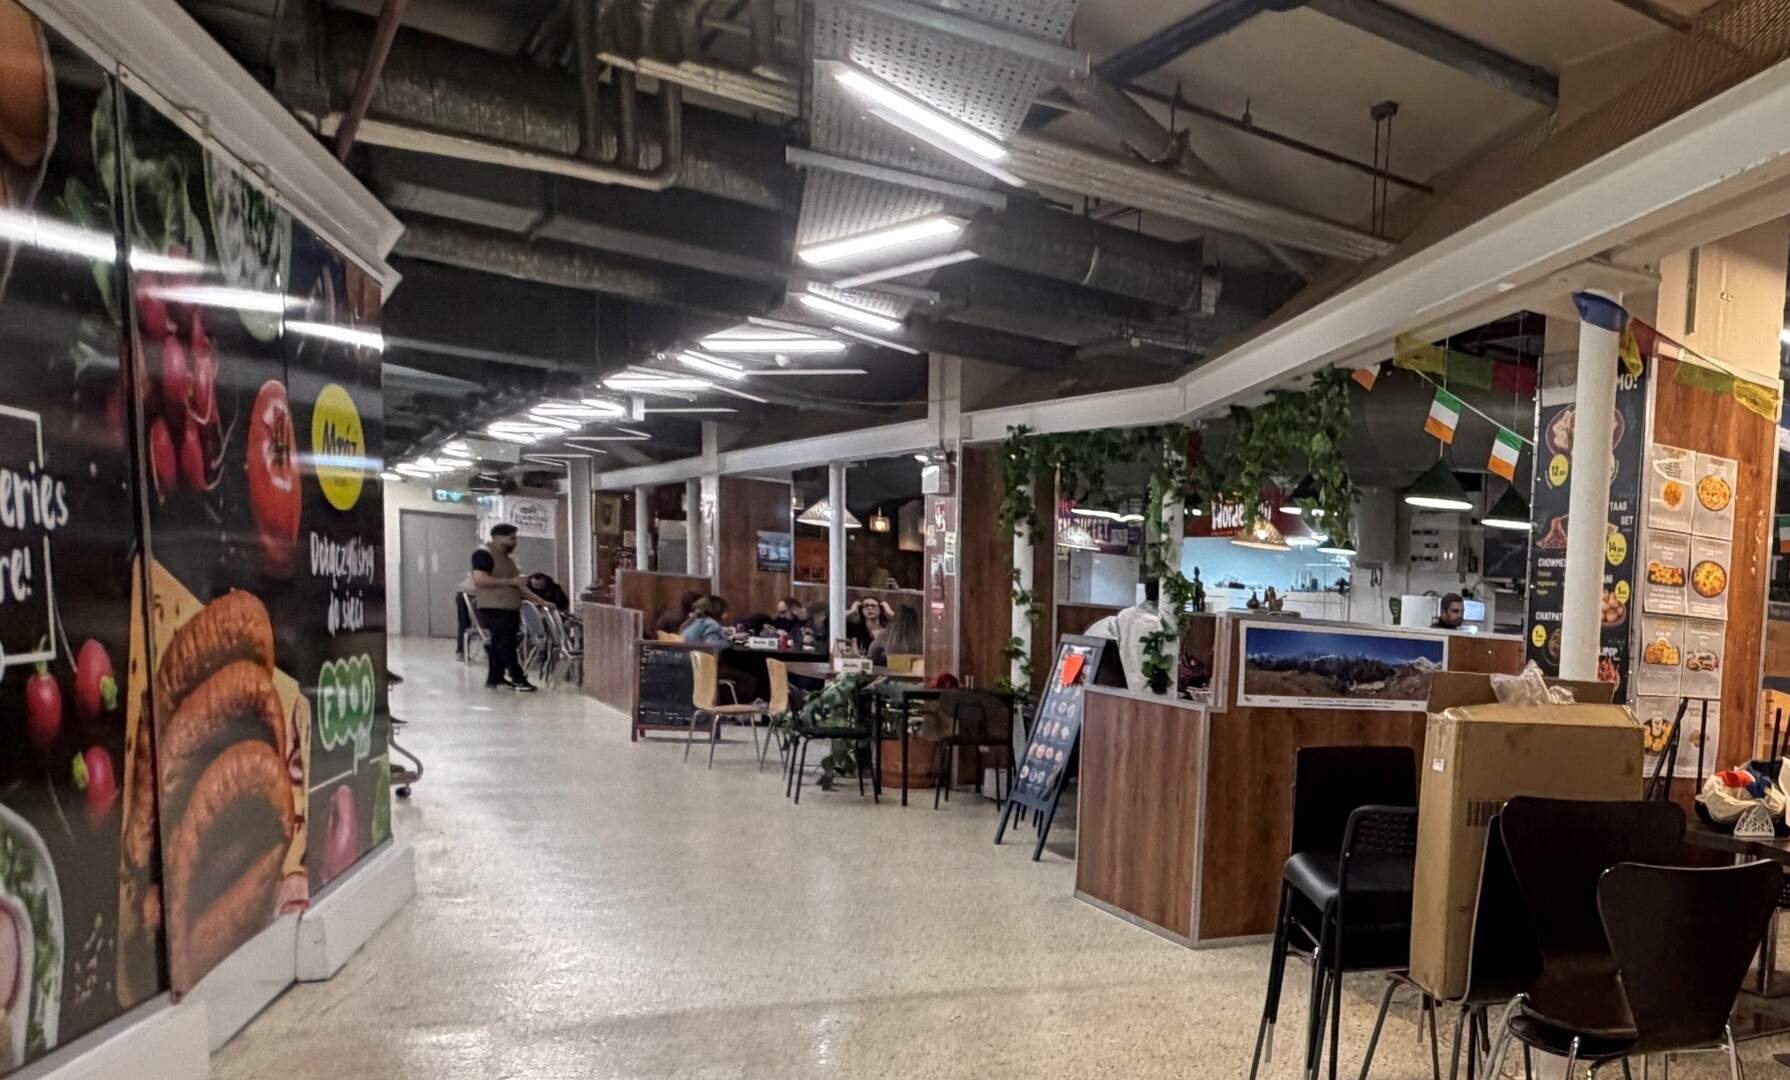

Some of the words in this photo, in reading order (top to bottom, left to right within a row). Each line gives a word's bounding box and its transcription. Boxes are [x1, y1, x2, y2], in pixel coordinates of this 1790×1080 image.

[0, 461, 68, 530] eries
[0, 546, 32, 602] re!
[1535, 611, 1563, 622] CHATPAT
